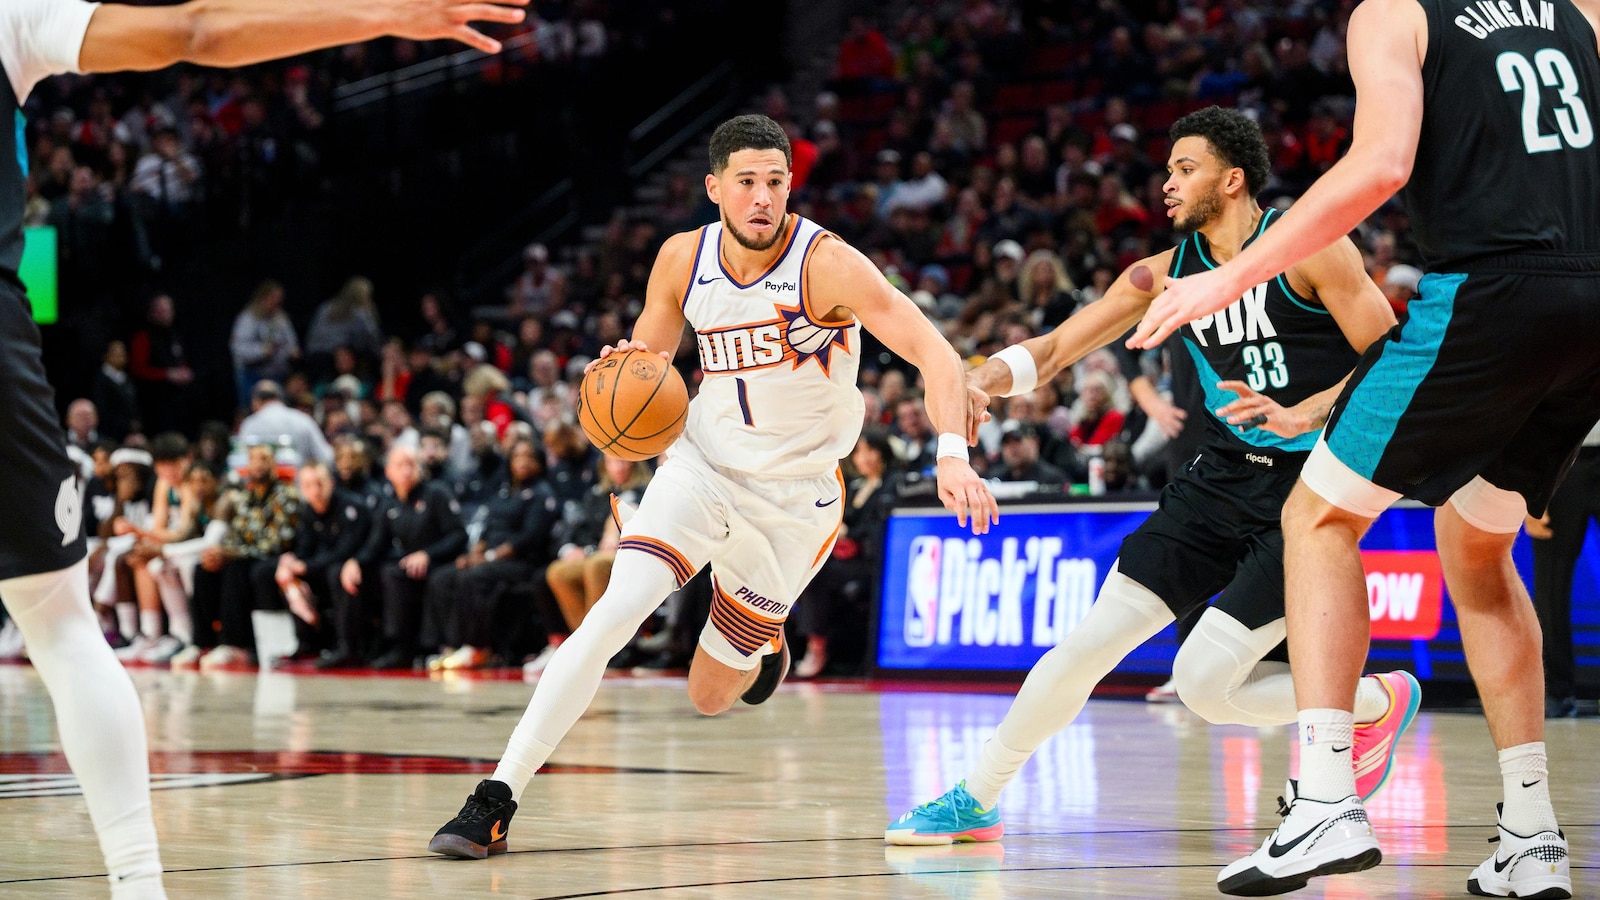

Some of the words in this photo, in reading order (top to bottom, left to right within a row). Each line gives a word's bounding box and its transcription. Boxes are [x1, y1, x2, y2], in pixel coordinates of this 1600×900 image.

[1454, 0, 1555, 40] CLINGAN
[1495, 48, 1594, 154] 23
[764, 281, 796, 293] PayPal
[697, 325, 784, 371] UNS
[1242, 341, 1290, 392] 33
[735, 377, 756, 428] 1
[936, 536, 1098, 647] Pick'Em
